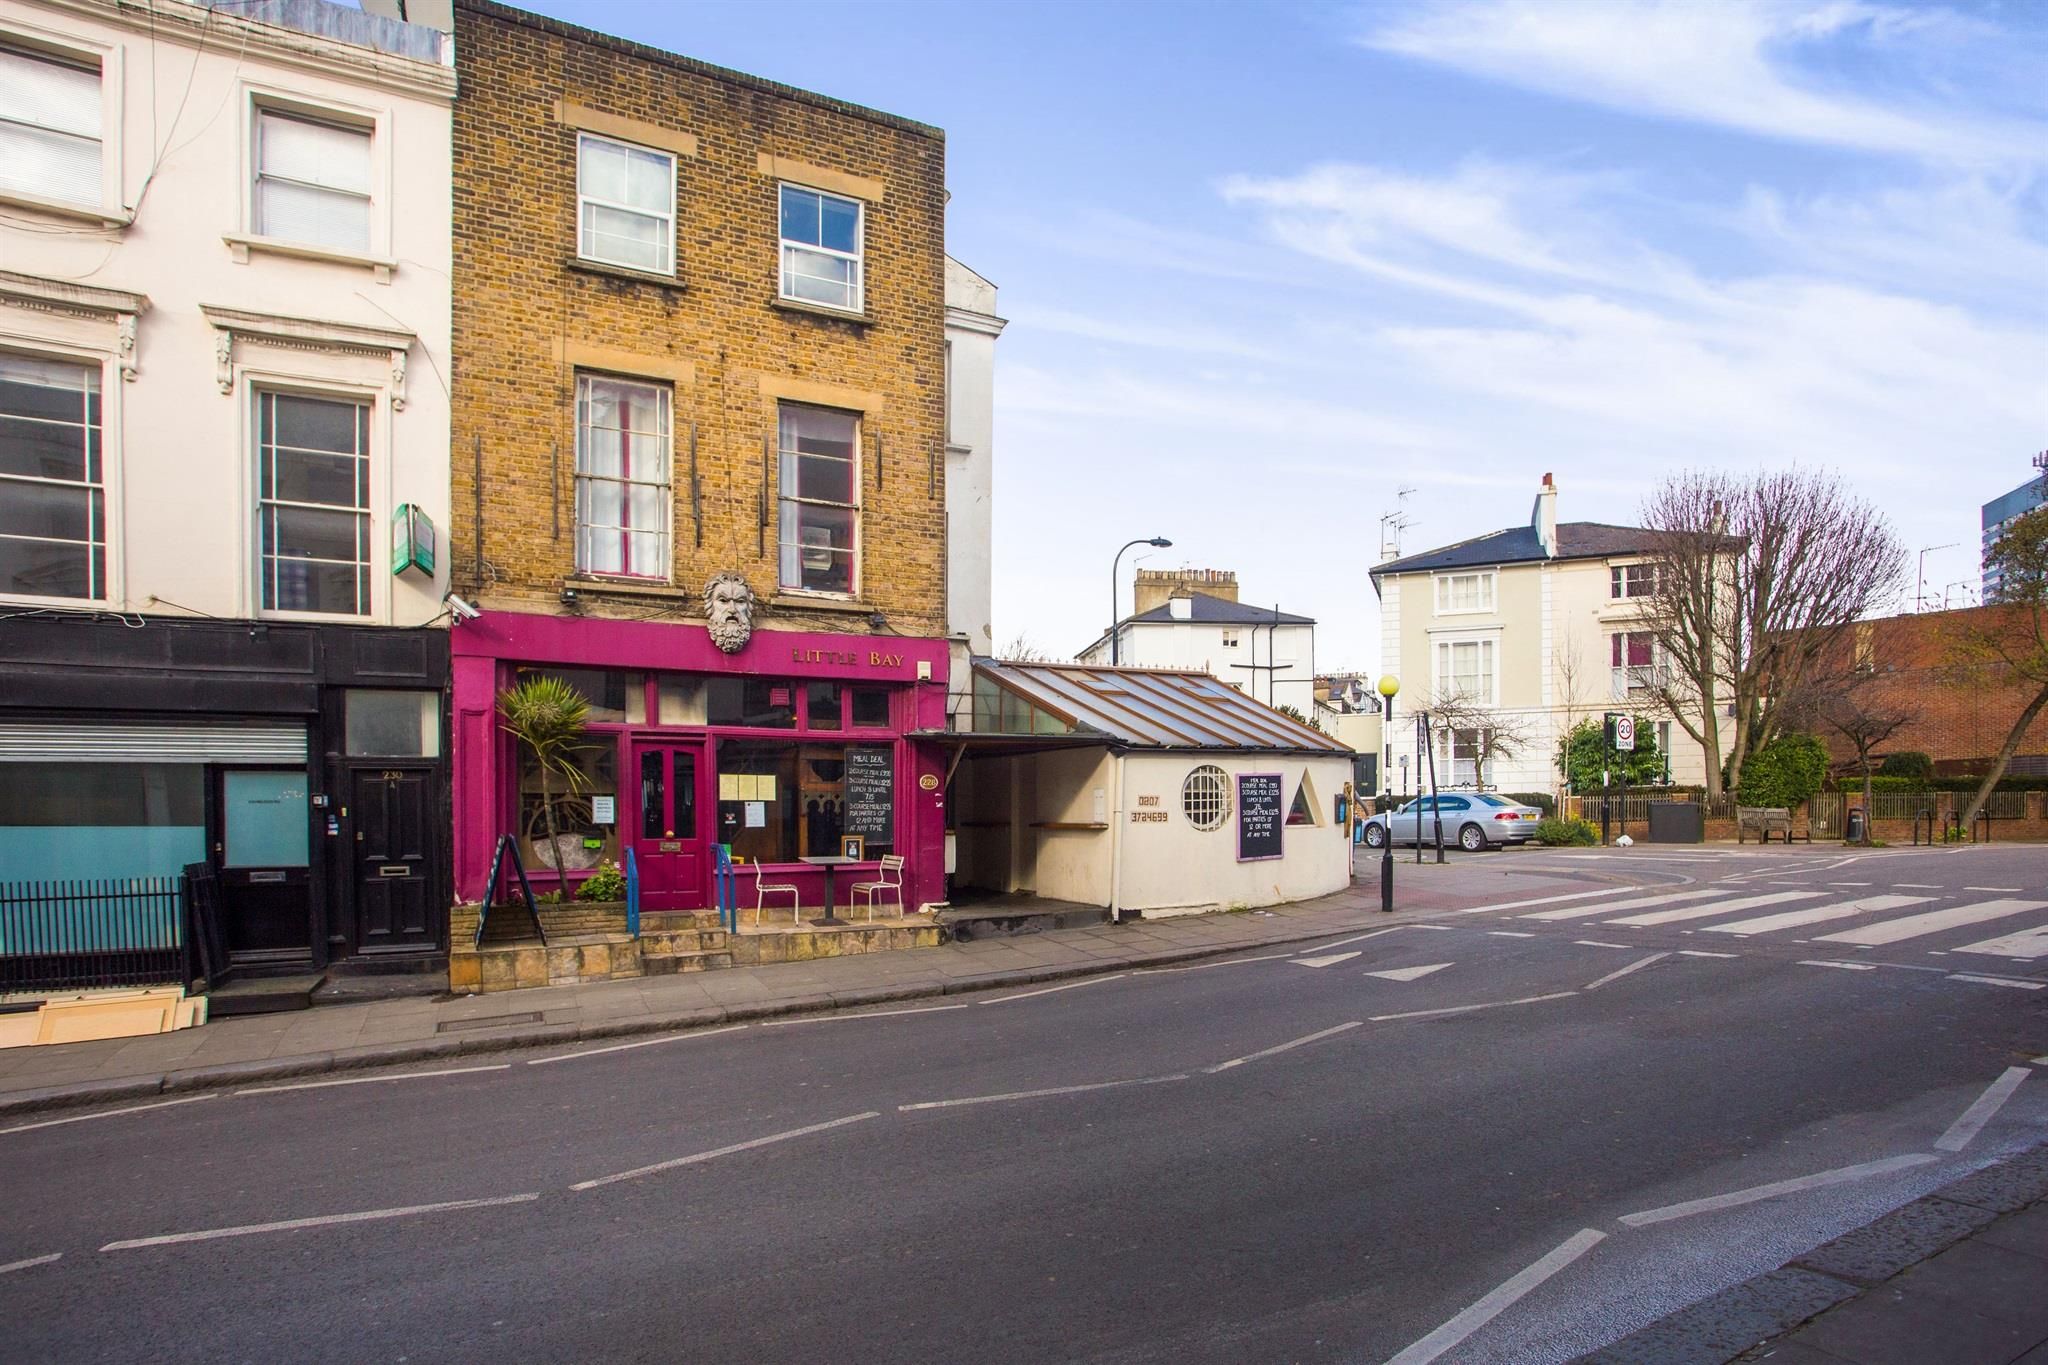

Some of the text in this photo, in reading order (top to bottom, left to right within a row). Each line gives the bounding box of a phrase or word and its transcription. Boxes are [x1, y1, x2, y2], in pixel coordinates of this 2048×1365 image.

[793, 649, 904, 667] LITTLE BAY
[1620, 724, 1630, 734] 20
[383, 771, 402, 779] 230
[1138, 796, 1159, 806] 0207
[1131, 812, 1168, 822] 3724699
